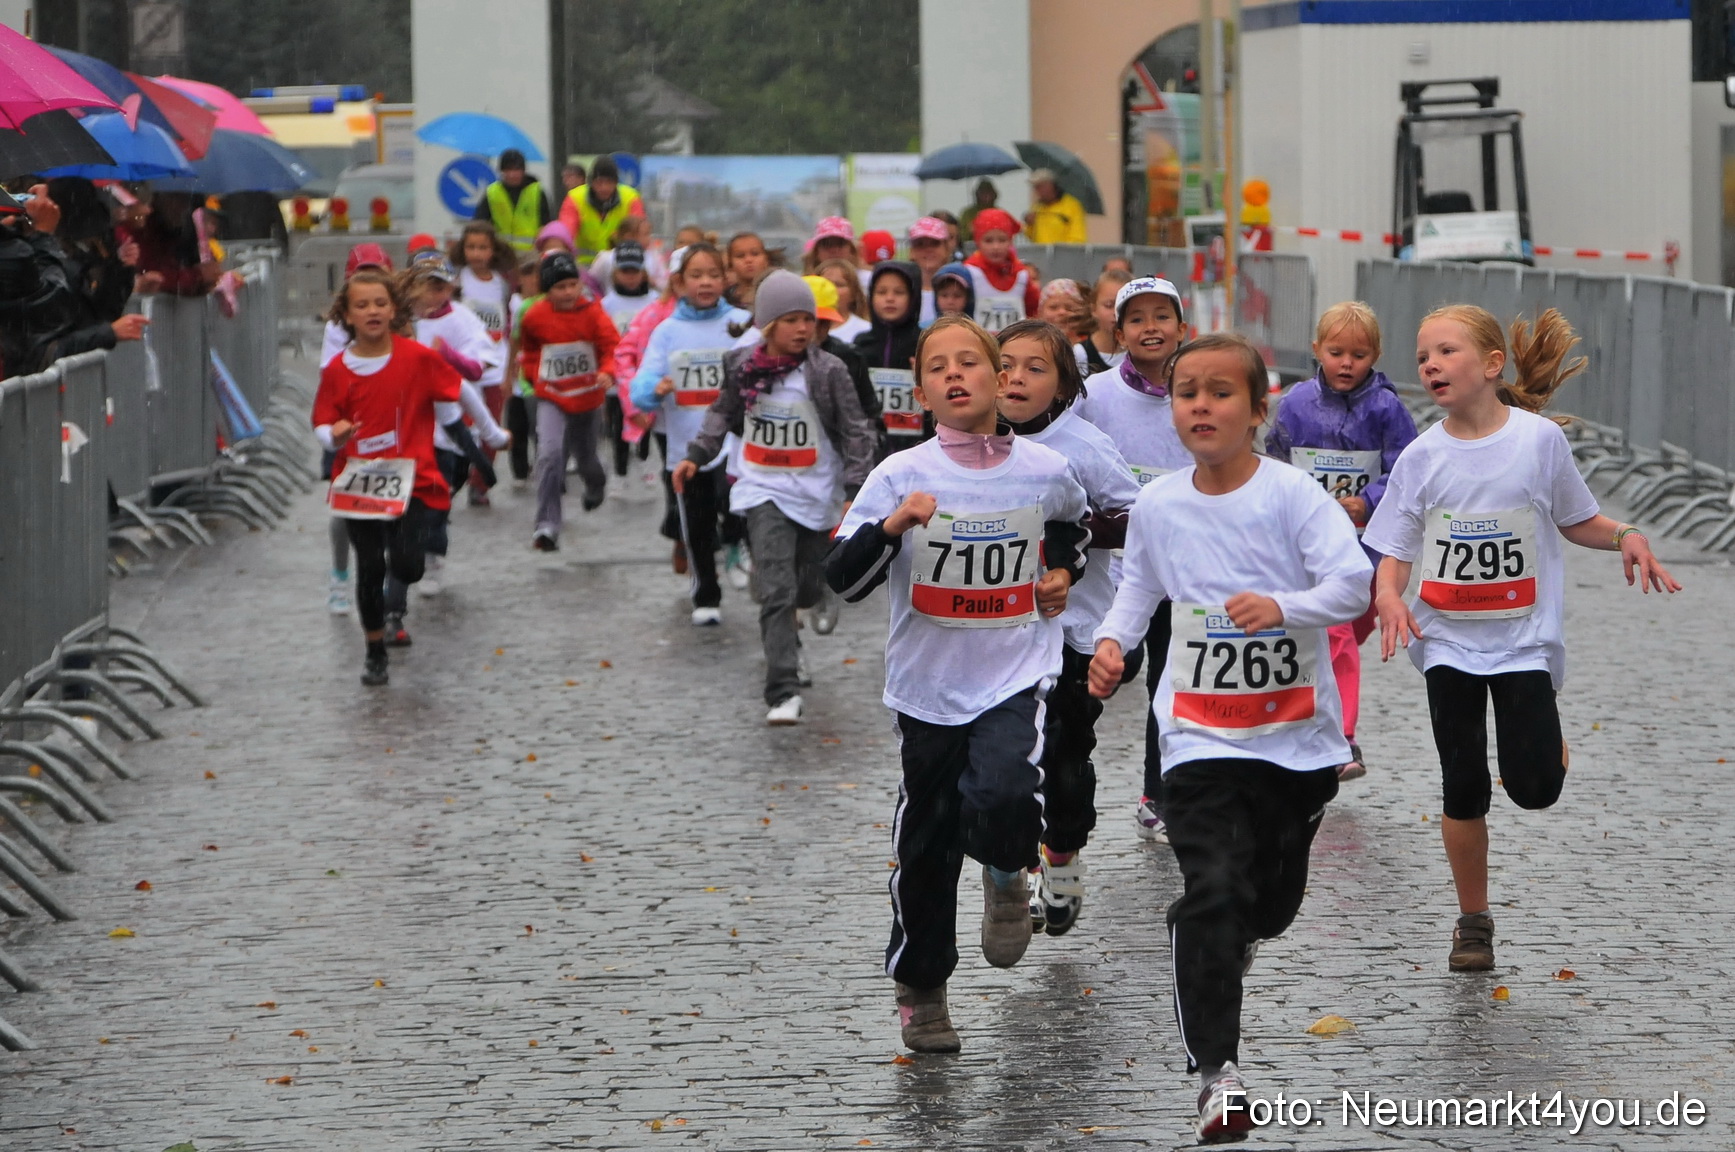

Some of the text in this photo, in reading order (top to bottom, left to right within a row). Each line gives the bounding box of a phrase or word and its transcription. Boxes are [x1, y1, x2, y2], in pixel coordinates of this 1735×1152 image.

[545, 354, 589, 378] 7066
[677, 365, 719, 388] 713
[875, 386, 913, 411] 151
[750, 416, 807, 447] 7010
[344, 472, 402, 498] 7123
[1308, 472, 1370, 500] 188
[952, 519, 1007, 533] BOCK
[1450, 520, 1498, 532] BOCK
[928, 539, 1029, 585] 7107
[1436, 538, 1524, 580] 7295
[952, 595, 1004, 613] Paula
[1206, 615, 1236, 629] BO
[1187, 638, 1299, 689] 7263
[1203, 698, 1251, 719] Marie
